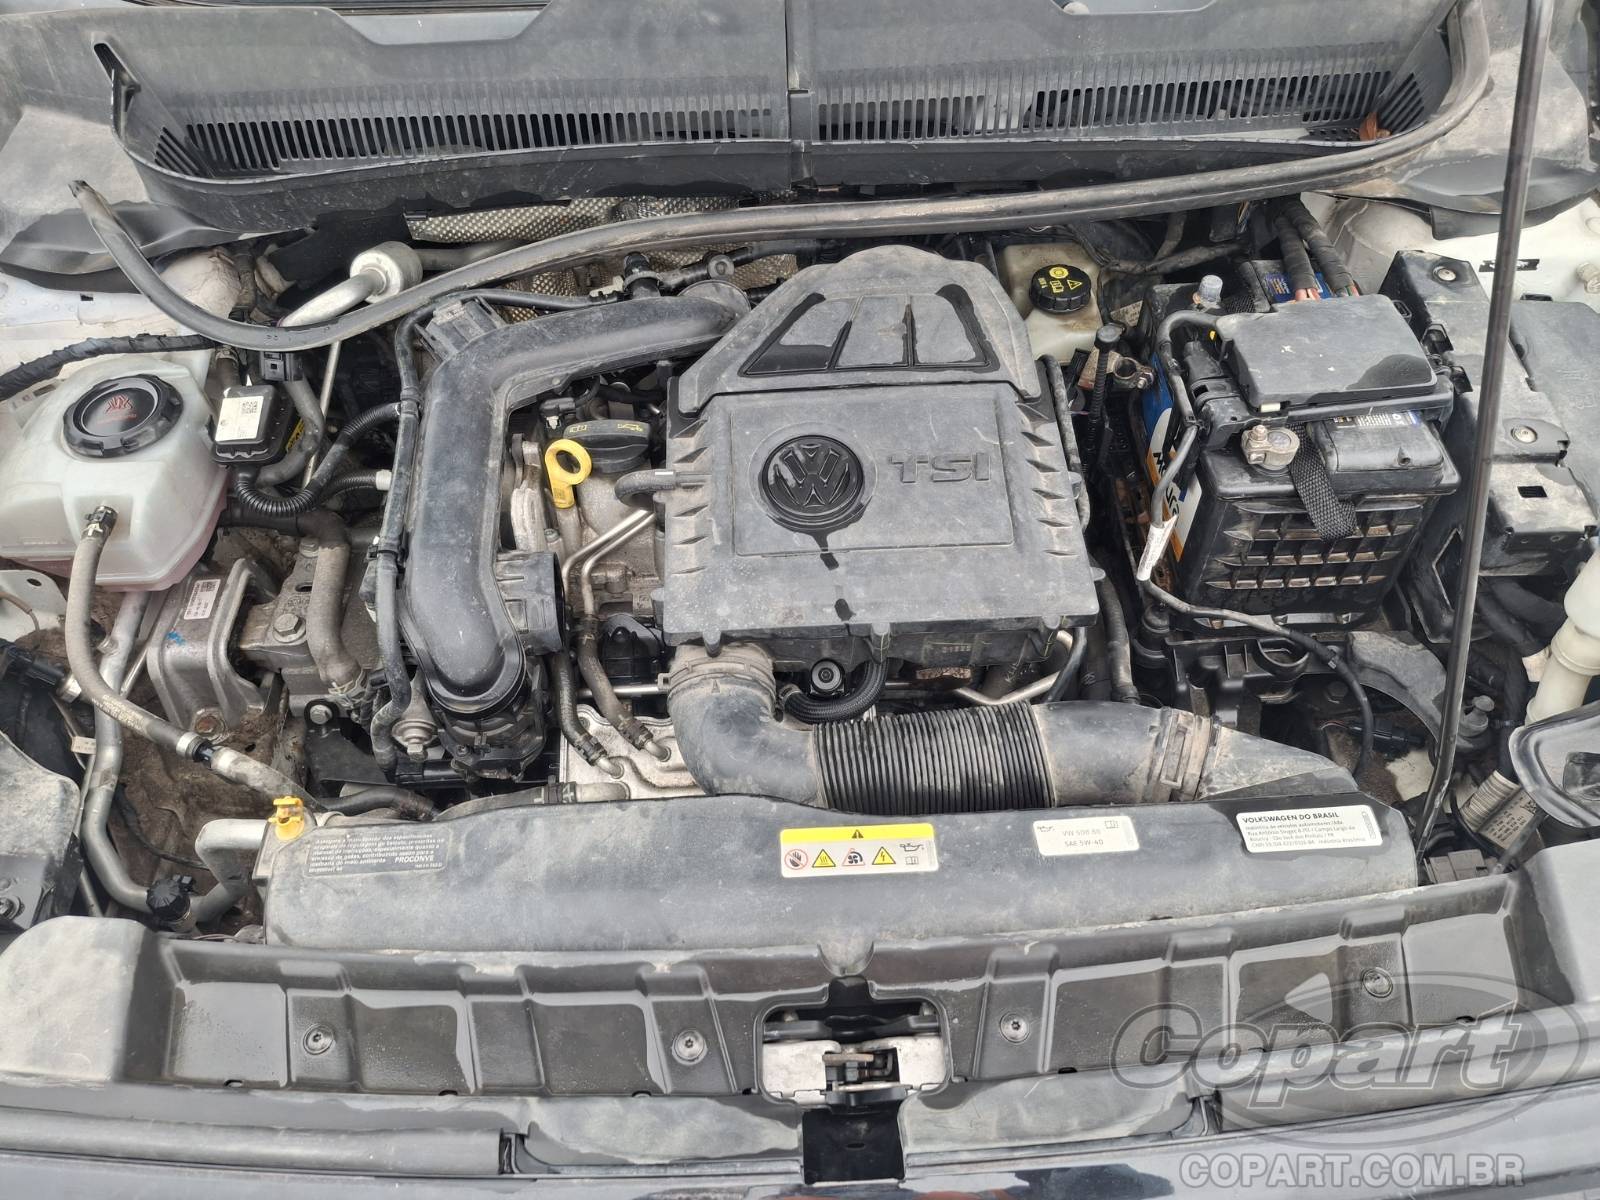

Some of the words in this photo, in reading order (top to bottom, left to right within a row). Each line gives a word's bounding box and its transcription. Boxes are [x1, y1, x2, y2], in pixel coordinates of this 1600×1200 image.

[888, 452, 991, 484] TSI
[1242, 815, 1298, 824] VOLKSWAGEN
[1312, 811, 1340, 819] BRASIL
